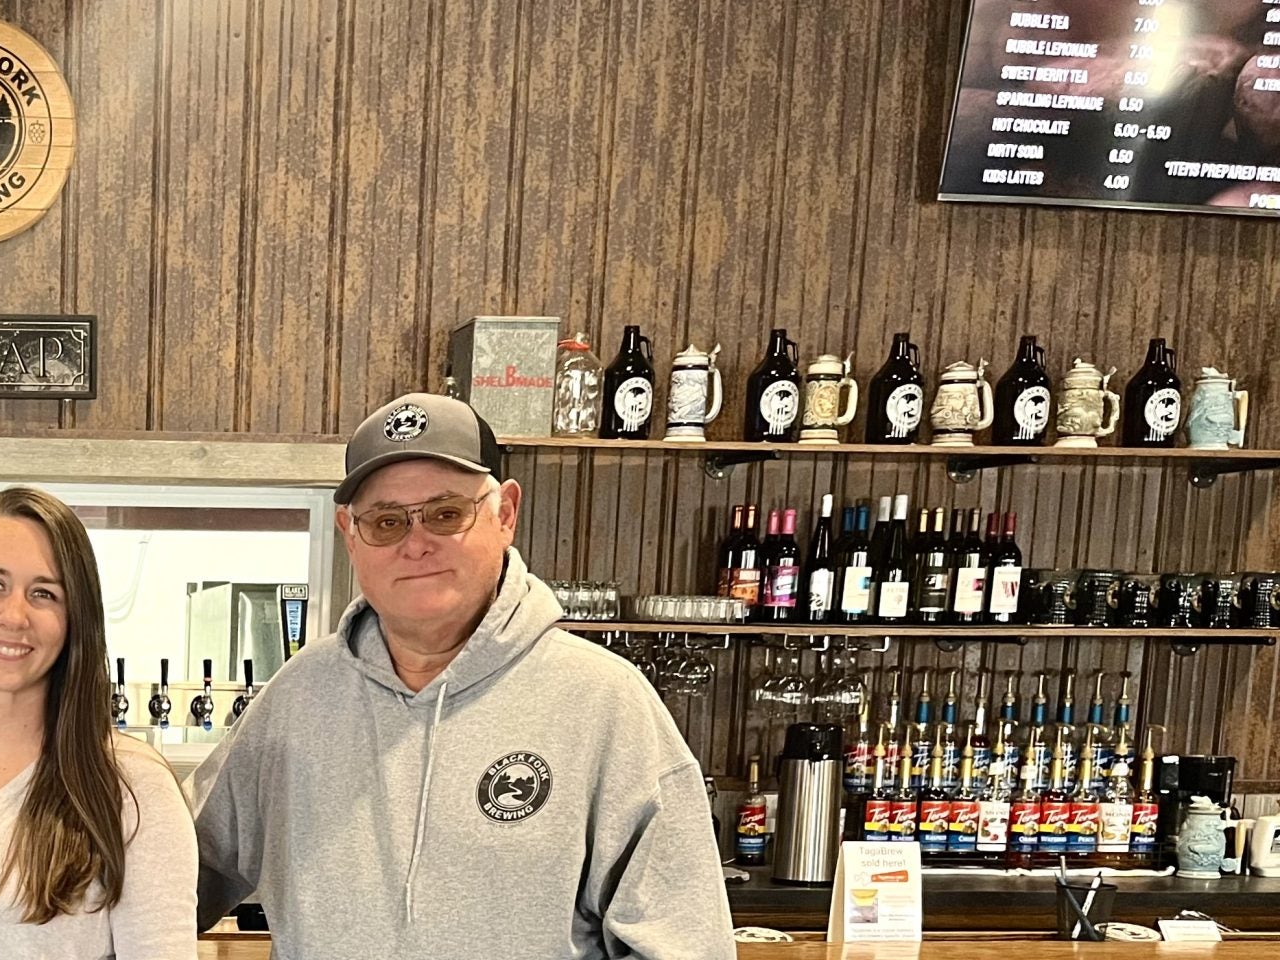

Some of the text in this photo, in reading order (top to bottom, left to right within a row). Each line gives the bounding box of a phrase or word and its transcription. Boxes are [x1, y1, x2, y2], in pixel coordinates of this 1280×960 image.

[1010, 12, 1070, 30] BUBBLE TEA
[1005, 38, 1099, 58] BUBBLE LEMONADE
[1001, 65, 1088, 84] SWEET BERRY TEA
[996, 91, 1105, 111] SPARKLING LEMONADE
[992, 117, 1071, 135] HOT CHOCOLATE
[987, 143, 1044, 159] DIRTY SODA
[982, 169, 1045, 185] KIDS LATTES
[1200, 163, 1257, 181] PREPARED
[488, 753, 549, 781] BLACK FORK
[483, 802, 534, 820] BREWING
[859, 847, 904, 856] TagaBrew
